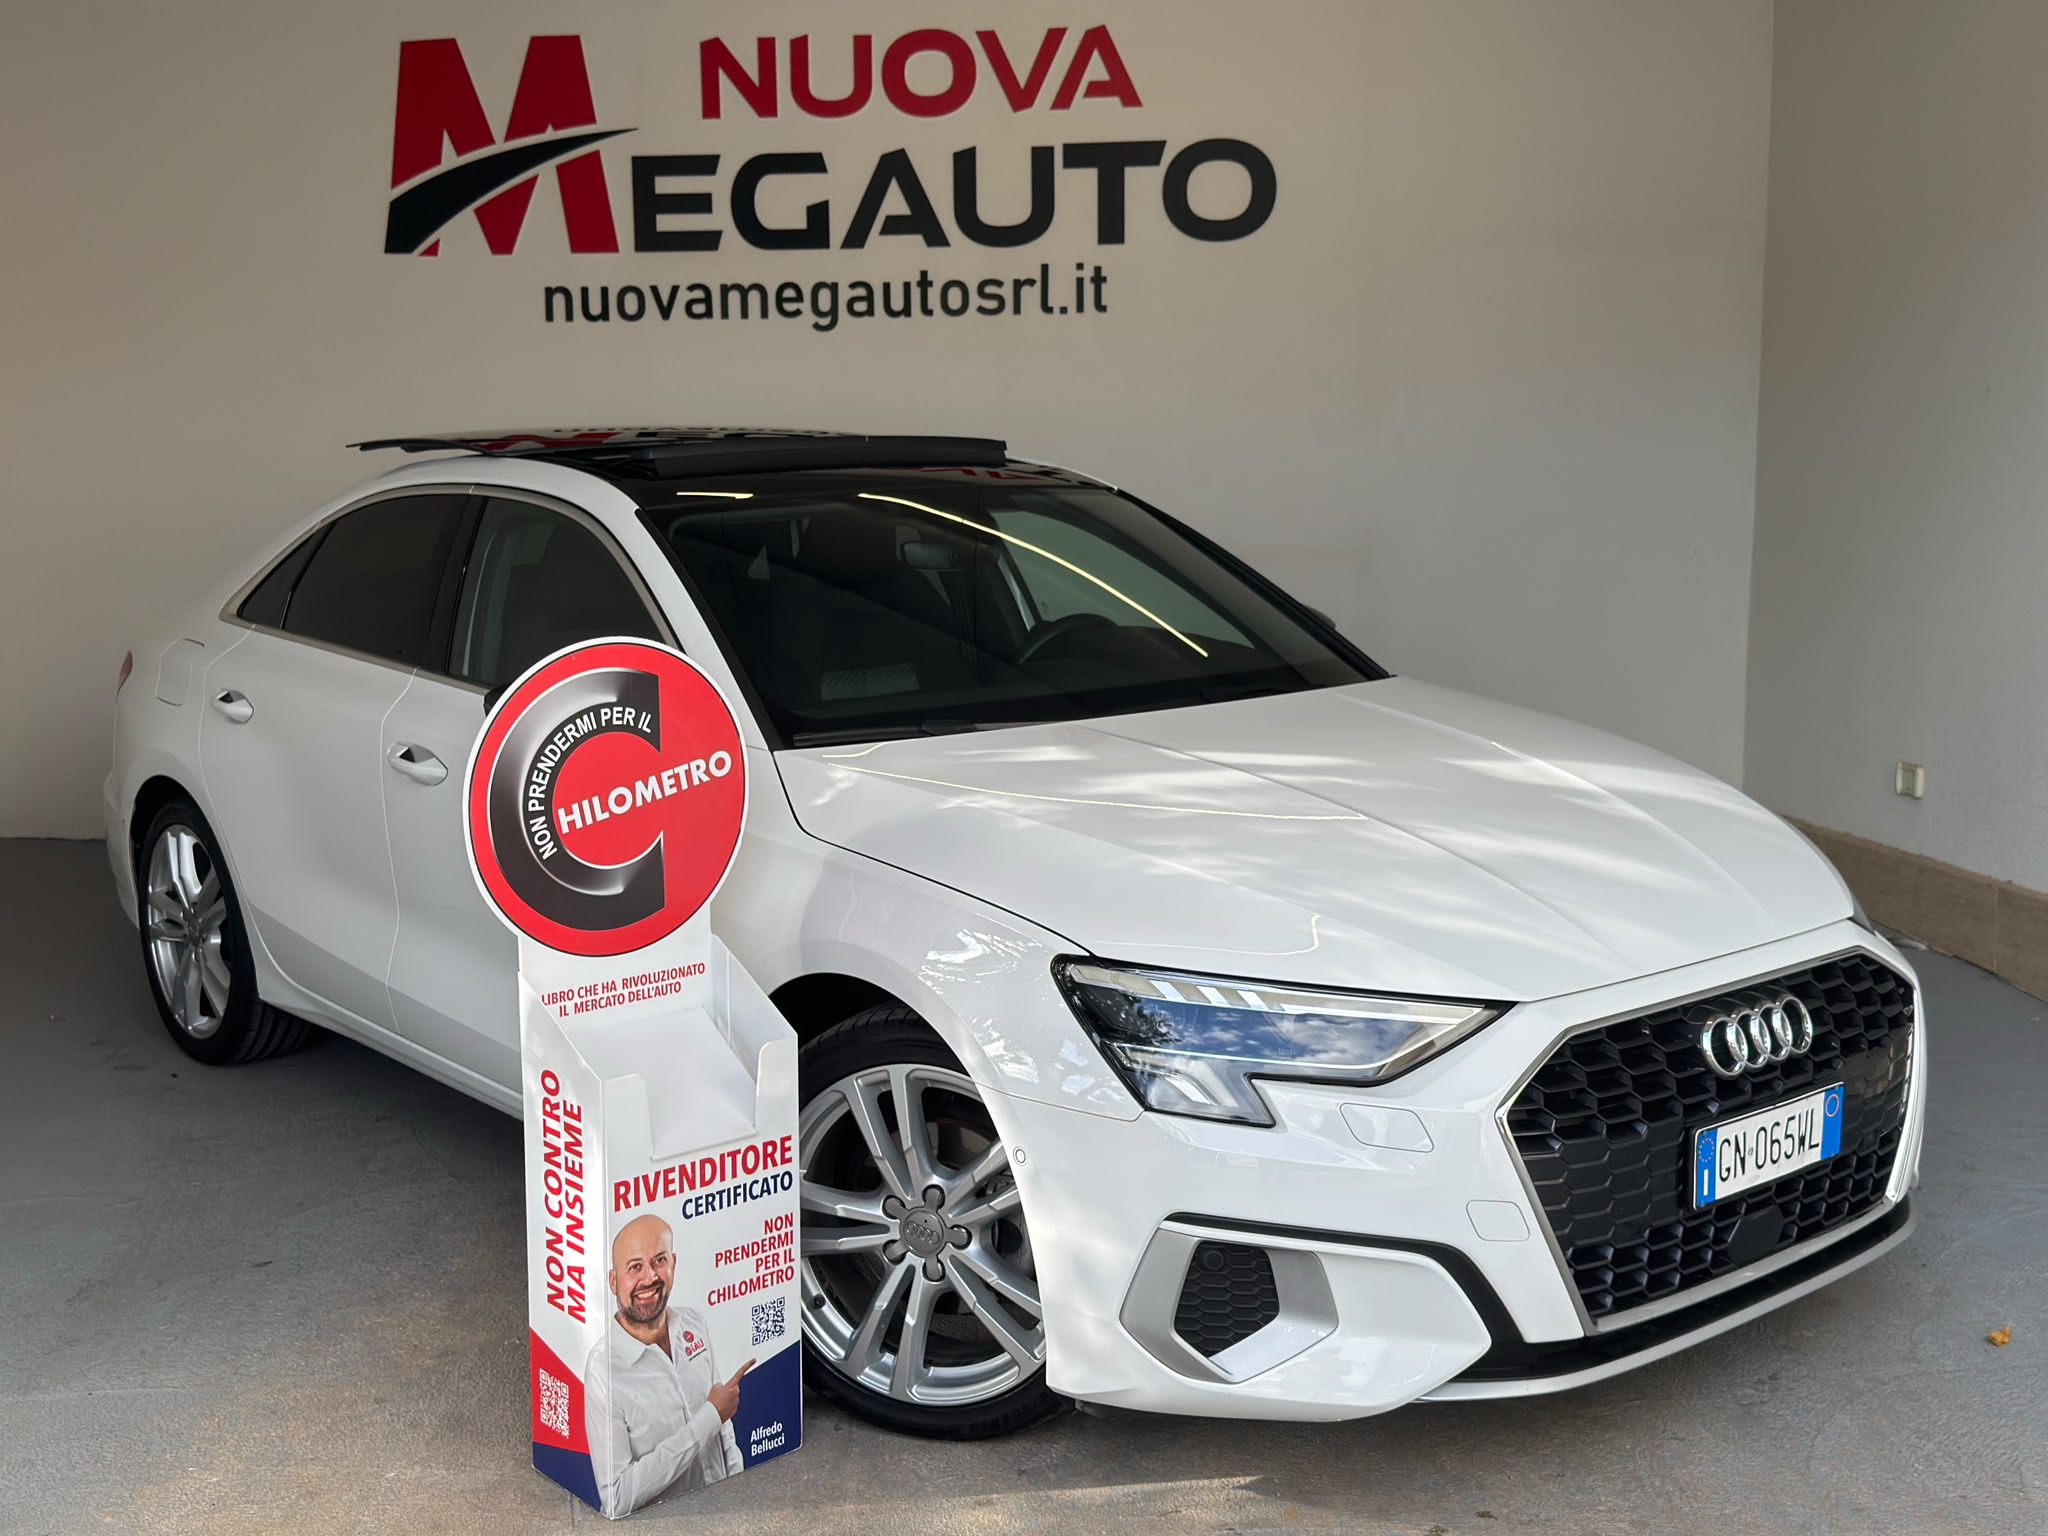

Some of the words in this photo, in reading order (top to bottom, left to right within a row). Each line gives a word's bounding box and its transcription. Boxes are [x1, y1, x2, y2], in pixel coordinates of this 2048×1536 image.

[699, 24, 1143, 120] NUOVA
[384, 35, 1277, 257] MEGAUTO
[544, 263, 1108, 332] nuovamegautosrl.it
[601, 706, 635, 727] PER
[638, 711, 653, 733] IL
[528, 712, 597, 812] PRENDERMI
[529, 816, 558, 860] NON
[541, 989, 575, 1006] LIBRO
[577, 983, 599, 999] CHE
[601, 980, 617, 994] HA
[622, 962, 706, 990] RIVOLUZIONATO
[559, 1004, 570, 1018] IL
[574, 992, 626, 1015] MERCATO
[540, 1069, 563, 1218] CONTRO
[562, 1099, 585, 1255] INSIEME
[613, 1134, 793, 1213] RIVENDITORE
[681, 1170, 793, 1220] CERTIFICATO
[763, 1212, 794, 1235] NON
[545, 1227, 565, 1312] NON
[715, 1230, 794, 1268] PRENDERMI
[755, 1251, 780, 1273] PER
[783, 1248, 795, 1266] IL
[567, 1266, 586, 1324] MA
[707, 1265, 795, 1307] CHILOMETRO
[750, 1420, 783, 1443] Alfredo
[751, 1433, 785, 1457] Bellucci
